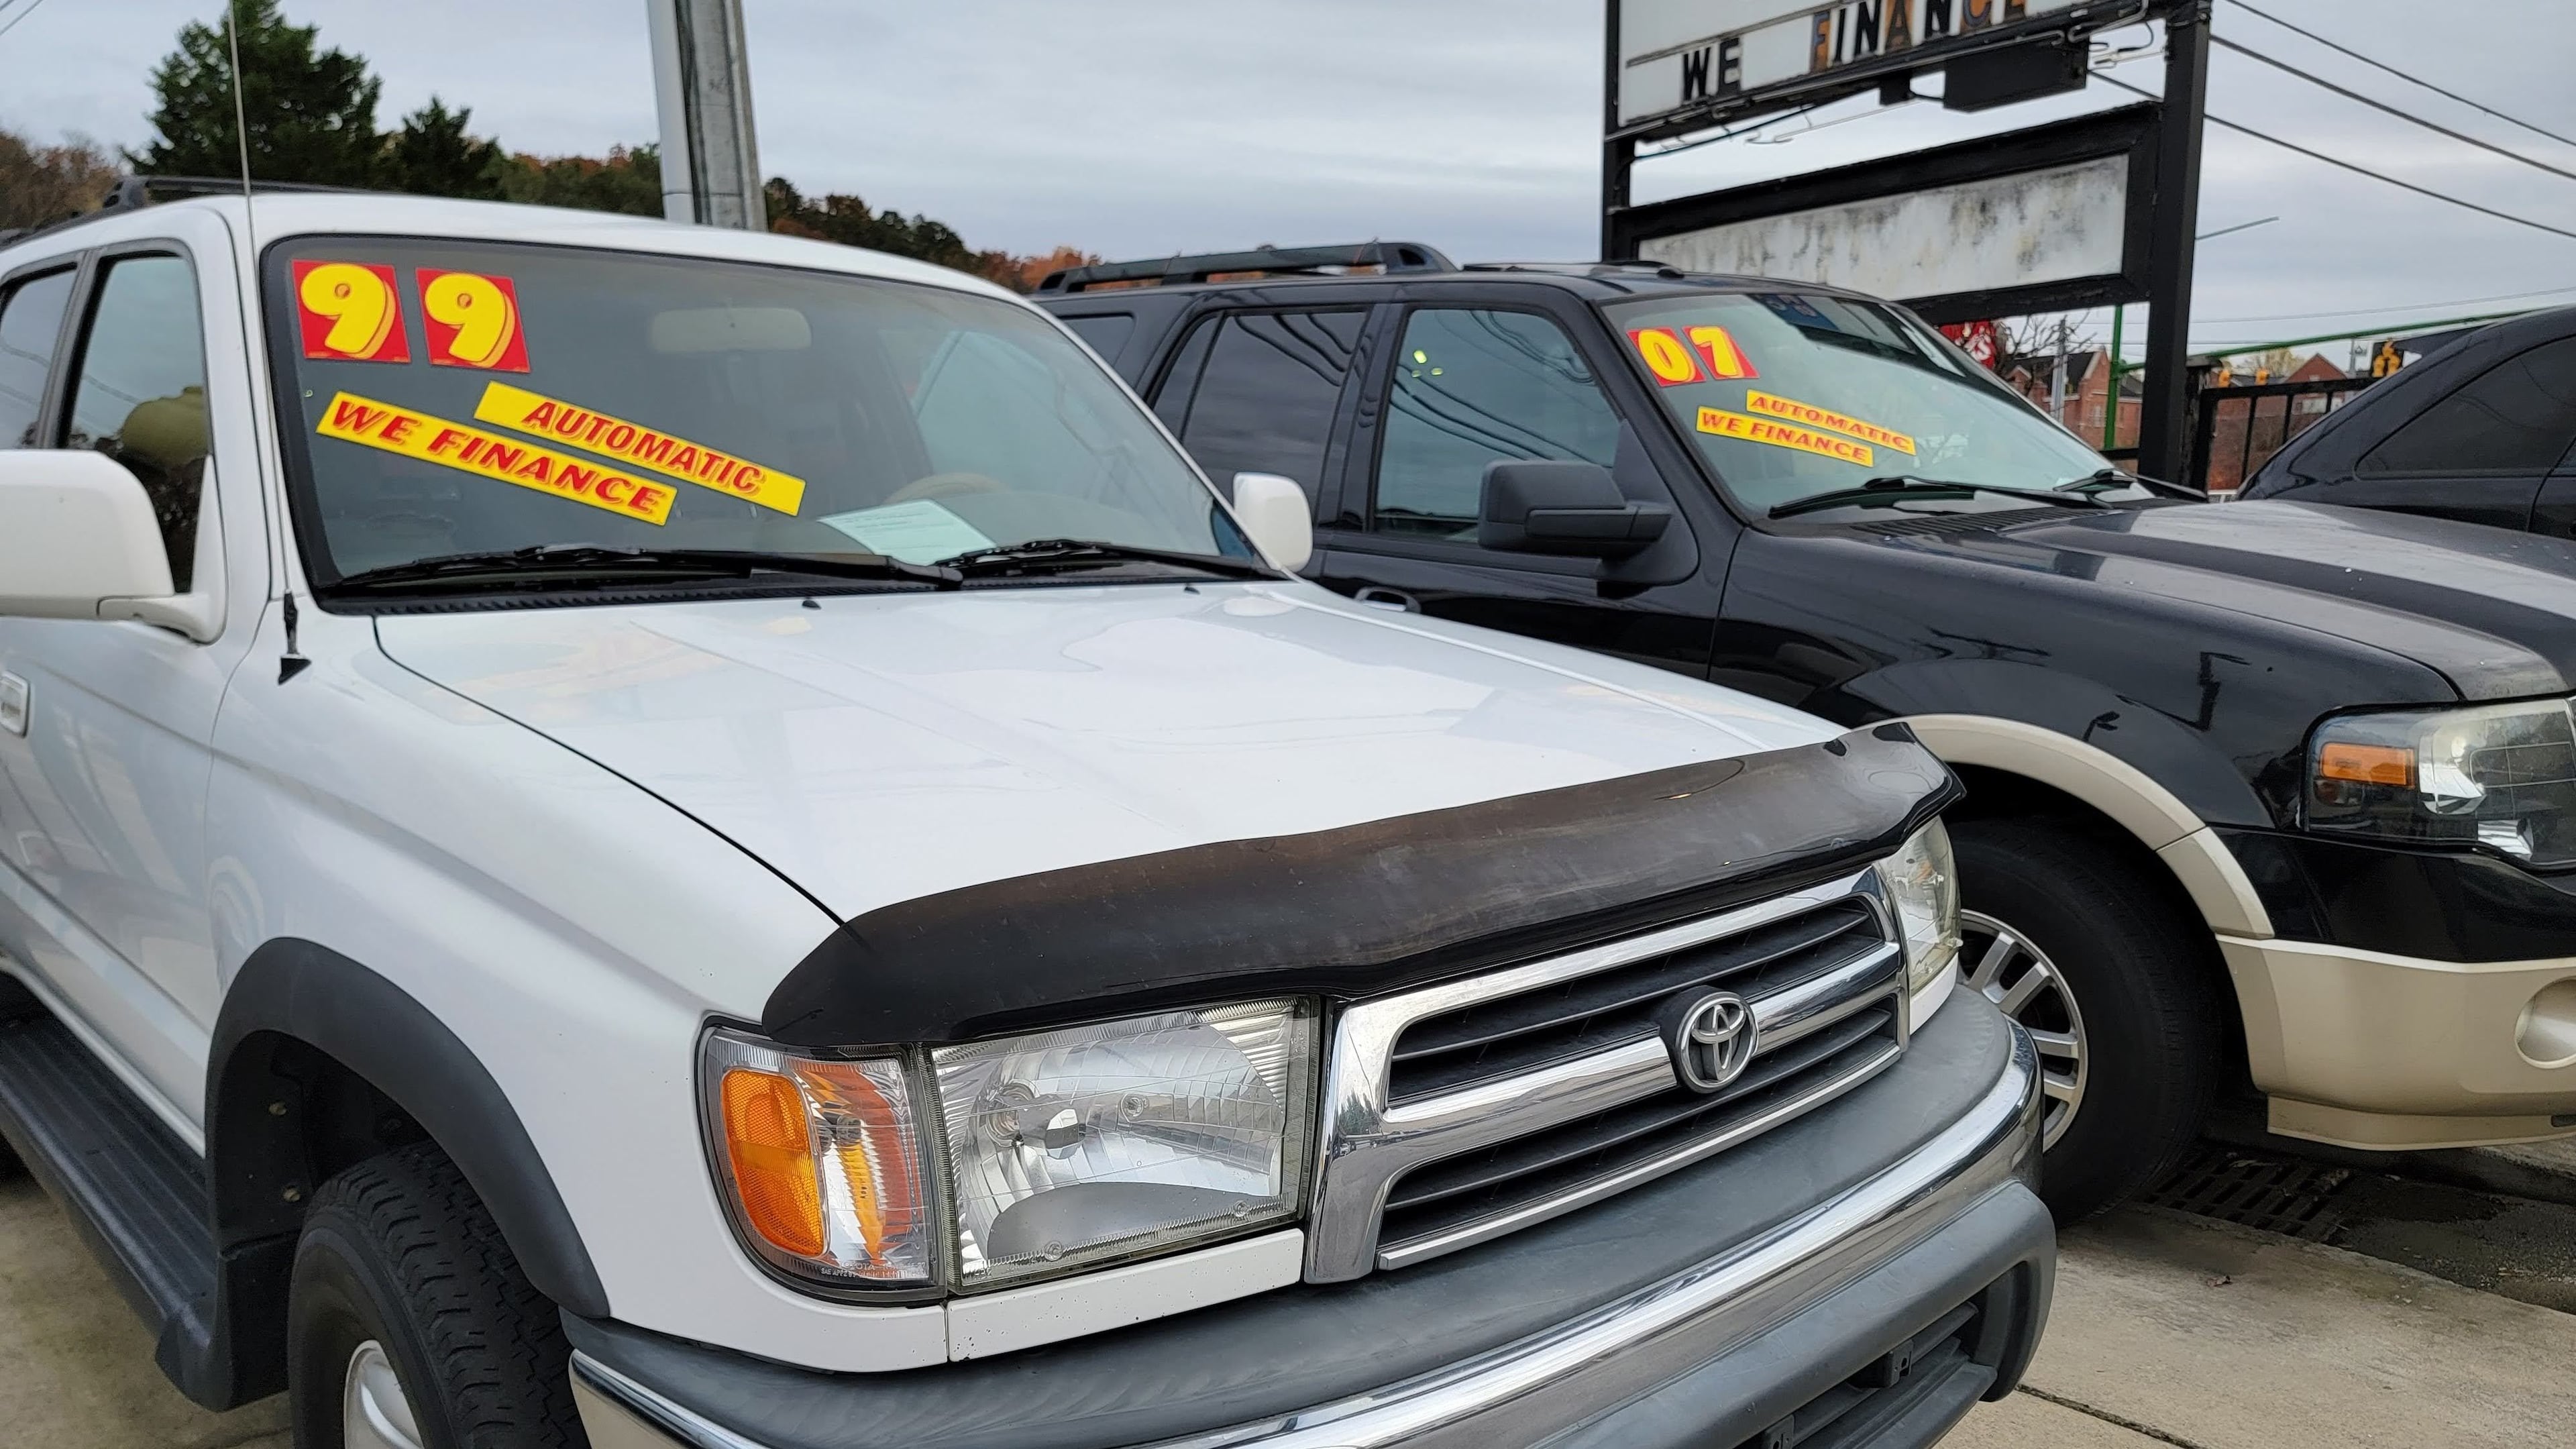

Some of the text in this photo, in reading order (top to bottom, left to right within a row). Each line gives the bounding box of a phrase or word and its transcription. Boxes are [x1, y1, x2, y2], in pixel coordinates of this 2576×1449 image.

[1682, 0, 2025, 101] WE FINAN
[301, 263, 515, 368] 99
[1638, 326, 1744, 382] 07
[331, 399, 664, 513] WE FINANCE
[521, 400, 765, 494] AUTOMATIC
[1702, 411, 1867, 462] WE FINANCE
[1751, 395, 1911, 450] AUTOMATIC
